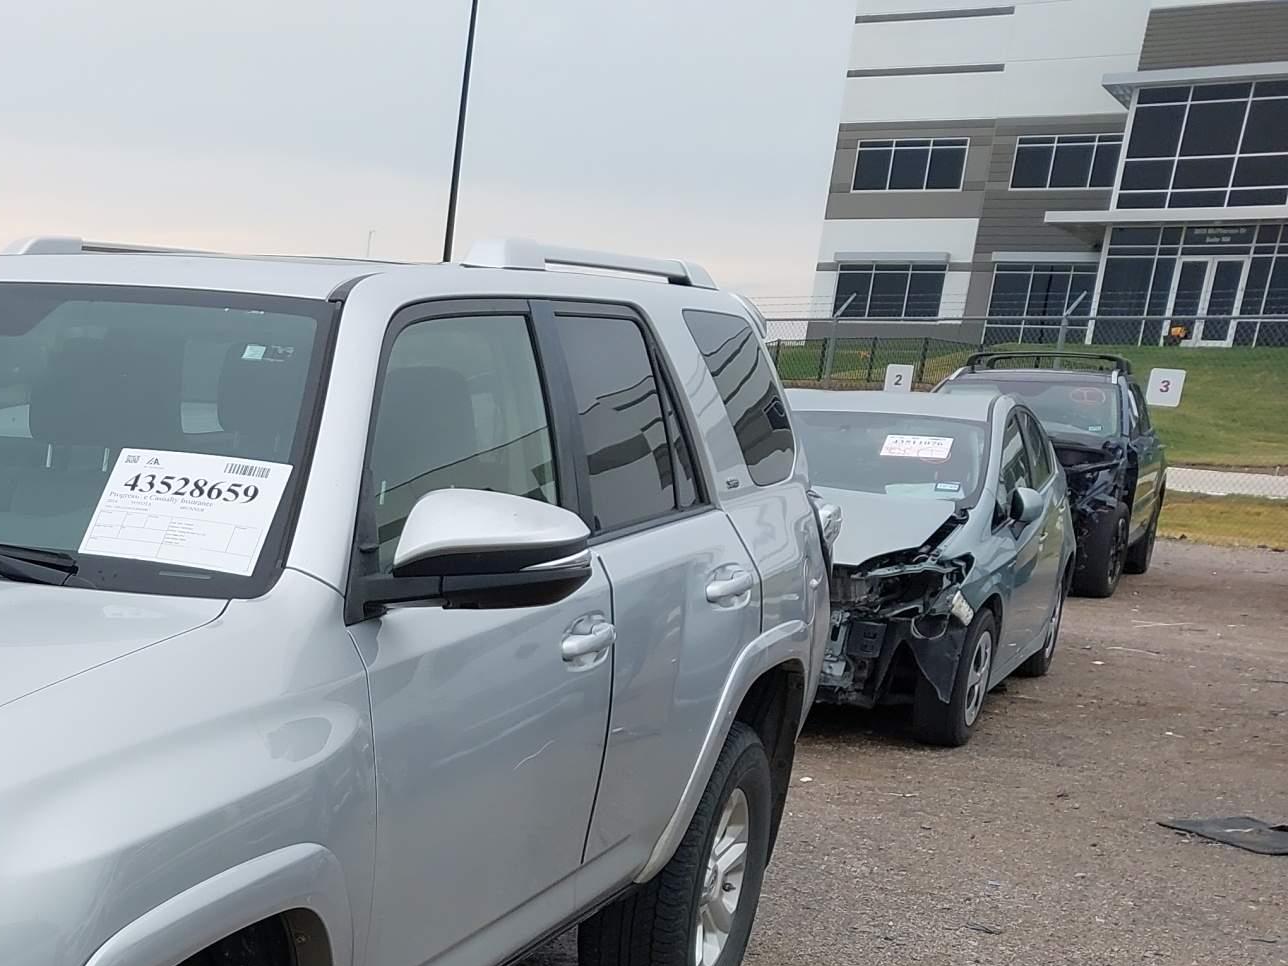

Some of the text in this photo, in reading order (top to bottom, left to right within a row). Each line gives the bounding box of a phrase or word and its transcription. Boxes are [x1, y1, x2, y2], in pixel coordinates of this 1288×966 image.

[894, 375, 903, 386] 2
[1159, 380, 1171, 393] 3
[124, 472, 259, 503] 43528659
